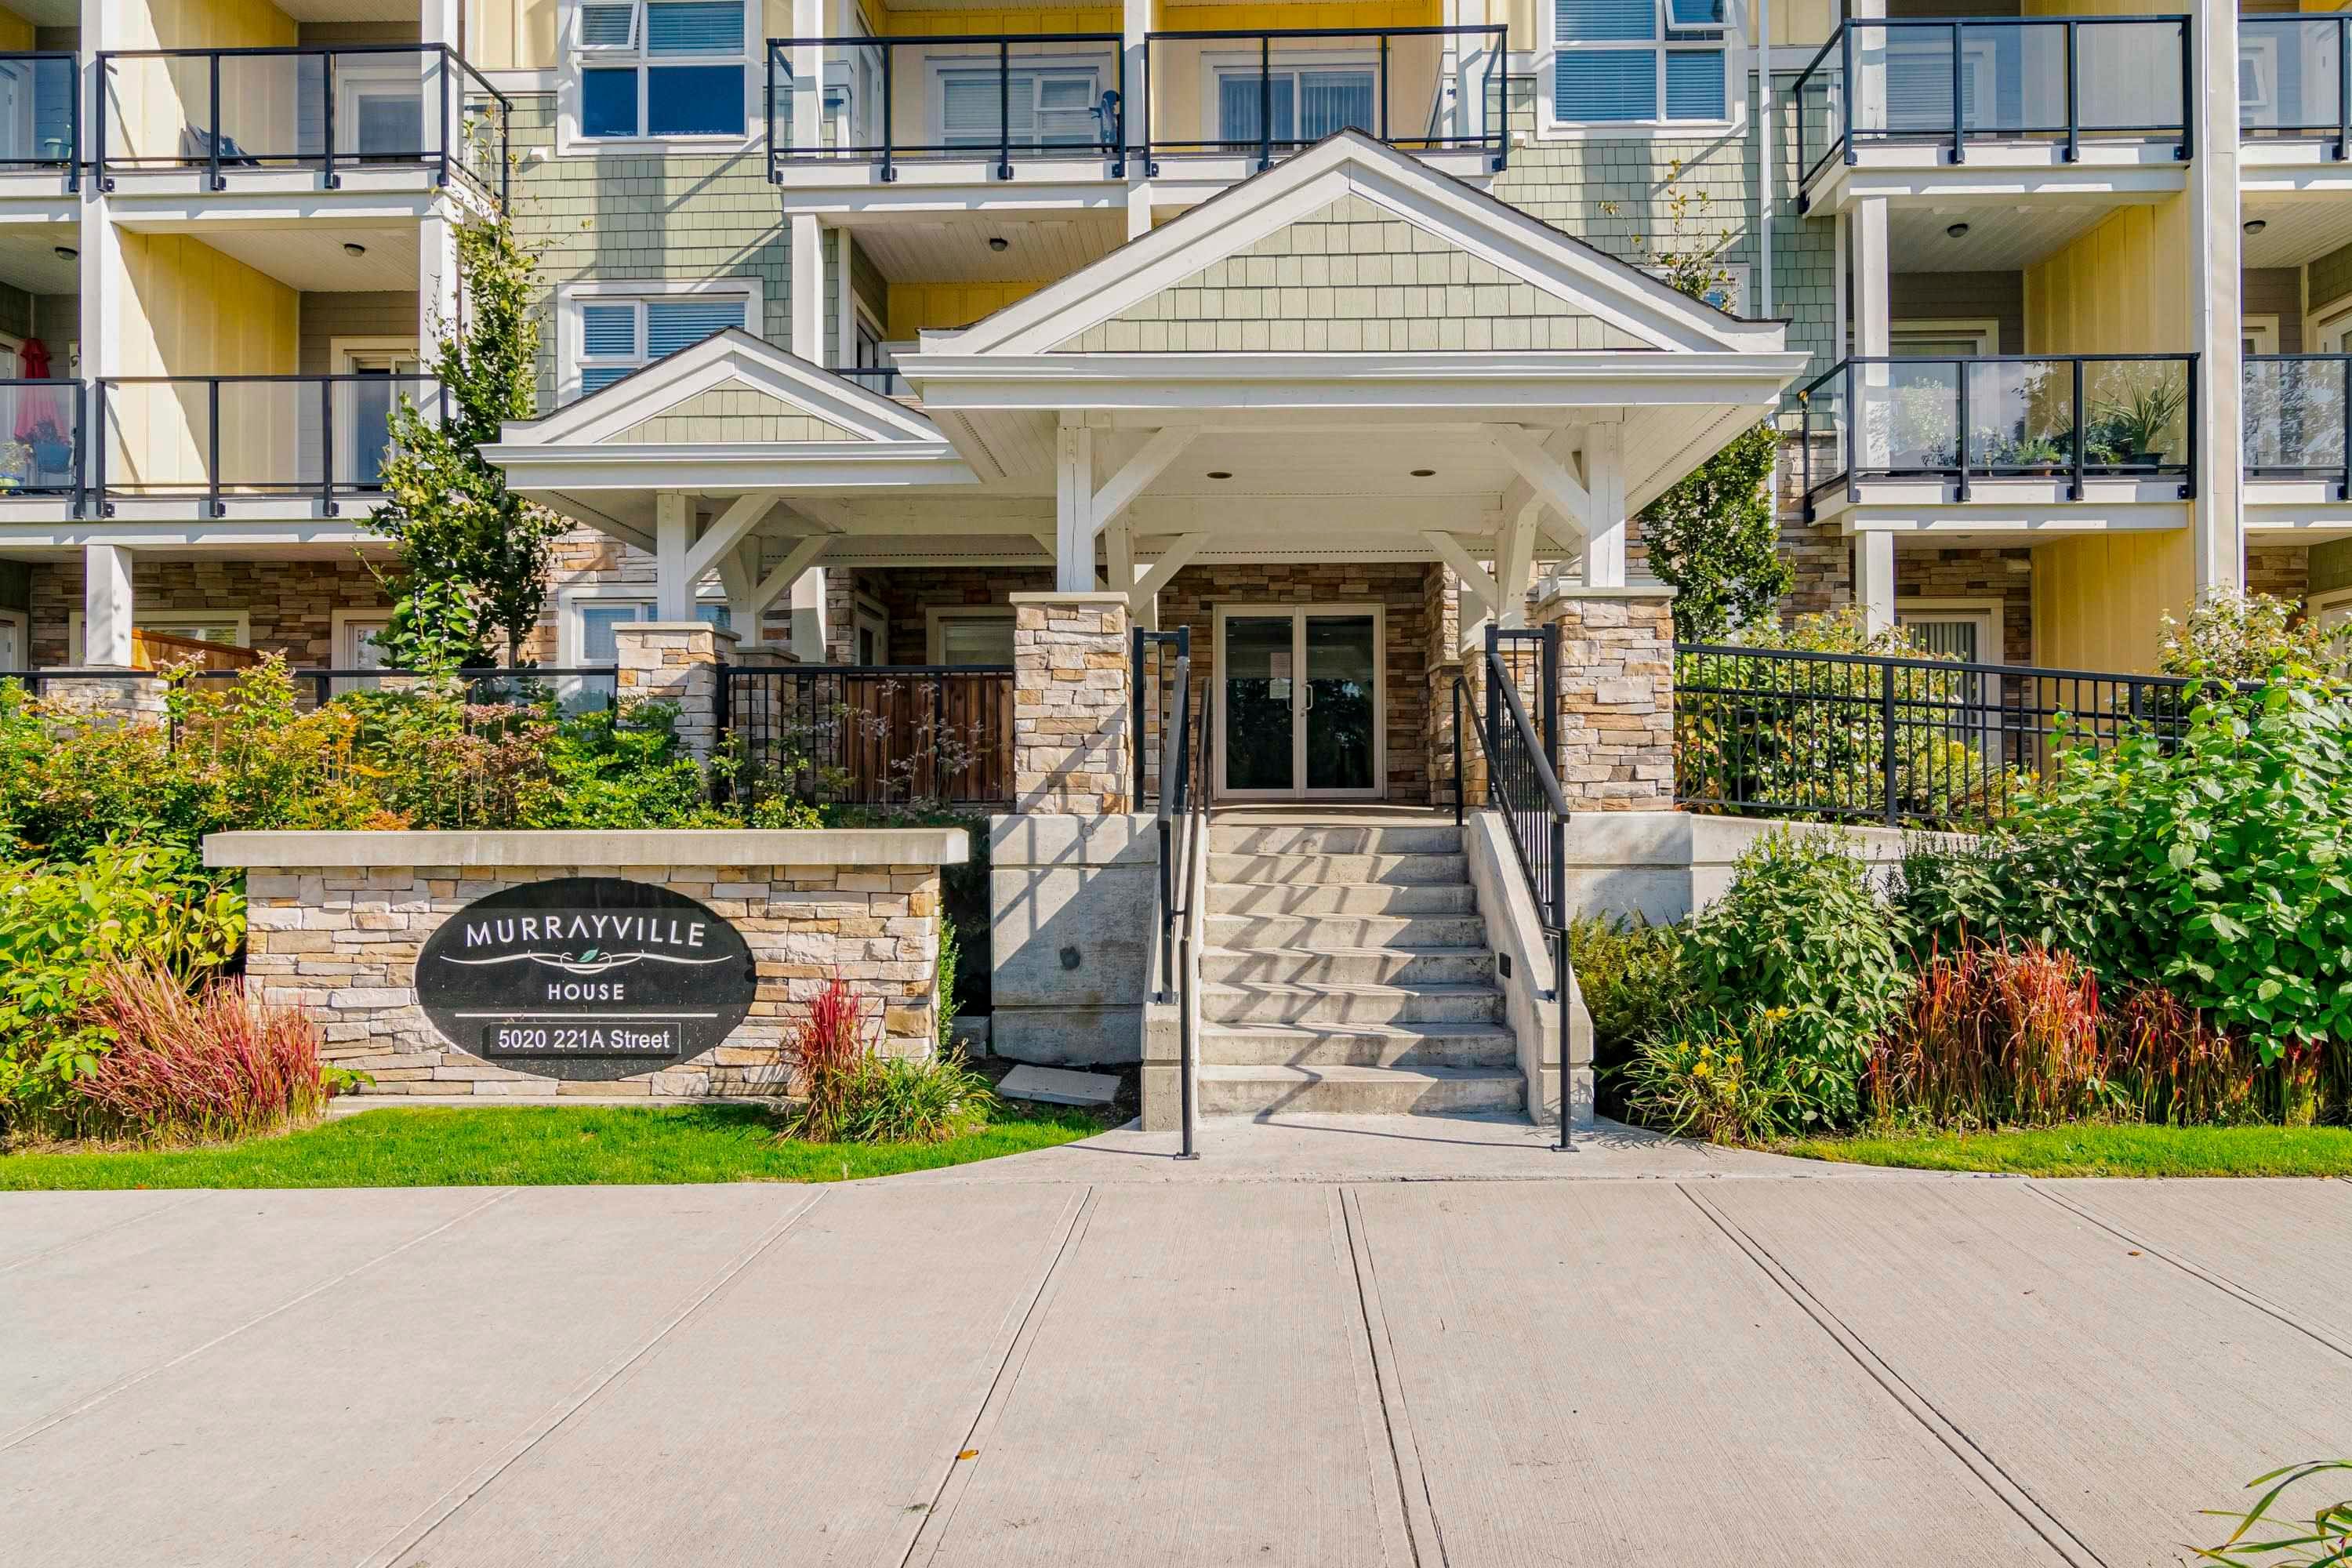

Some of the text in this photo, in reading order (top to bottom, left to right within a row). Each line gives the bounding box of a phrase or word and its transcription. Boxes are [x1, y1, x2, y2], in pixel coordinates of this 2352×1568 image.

[466, 915, 706, 947] MURRAYVILLE
[548, 983, 624, 1000] HOUSE
[498, 1029, 670, 1049] 5020 221A Street
